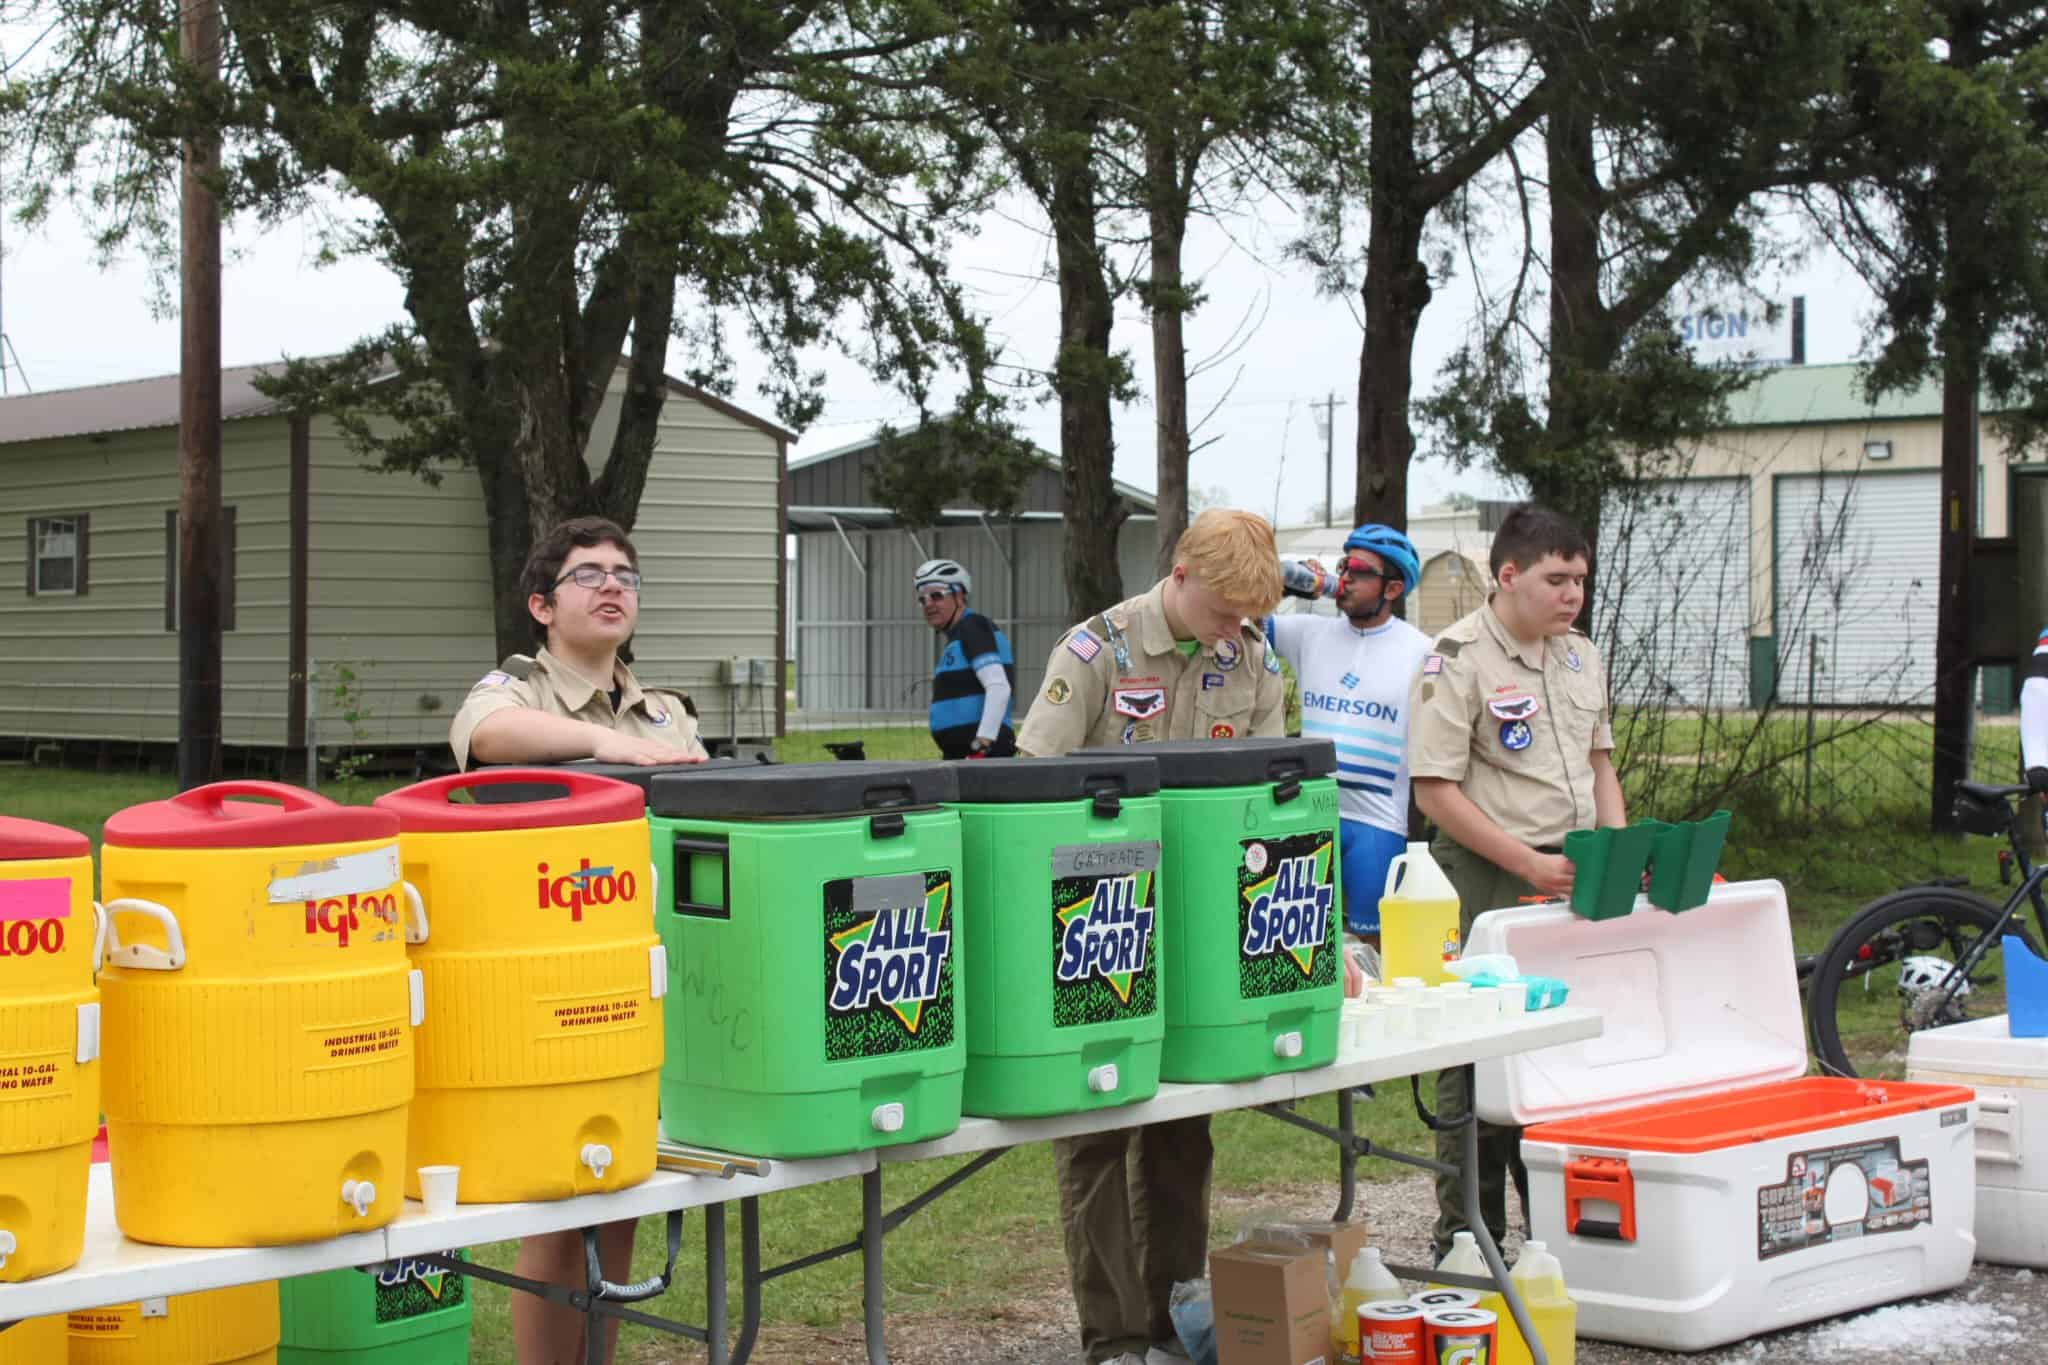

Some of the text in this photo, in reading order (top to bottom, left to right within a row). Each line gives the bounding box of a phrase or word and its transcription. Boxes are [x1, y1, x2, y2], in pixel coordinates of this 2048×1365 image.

[1303, 691, 1398, 723] EMERSON
[537, 858, 636, 921] igloo
[1088, 878, 1137, 926] ALL
[1272, 857, 1317, 902] ALL
[866, 907, 930, 953] ALL
[1244, 884, 1333, 954] SPORT
[1057, 908, 1153, 980] SPORT
[831, 931, 950, 1010] SPORT
[554, 1004, 609, 1017] INDUSTRIAL
[561, 1010, 636, 1027] DRINKING WATER
[324, 1032, 377, 1047] INDUSTRIAL
[330, 1043, 377, 1057] DRINKING
[21, 1075, 54, 1089] WATER
